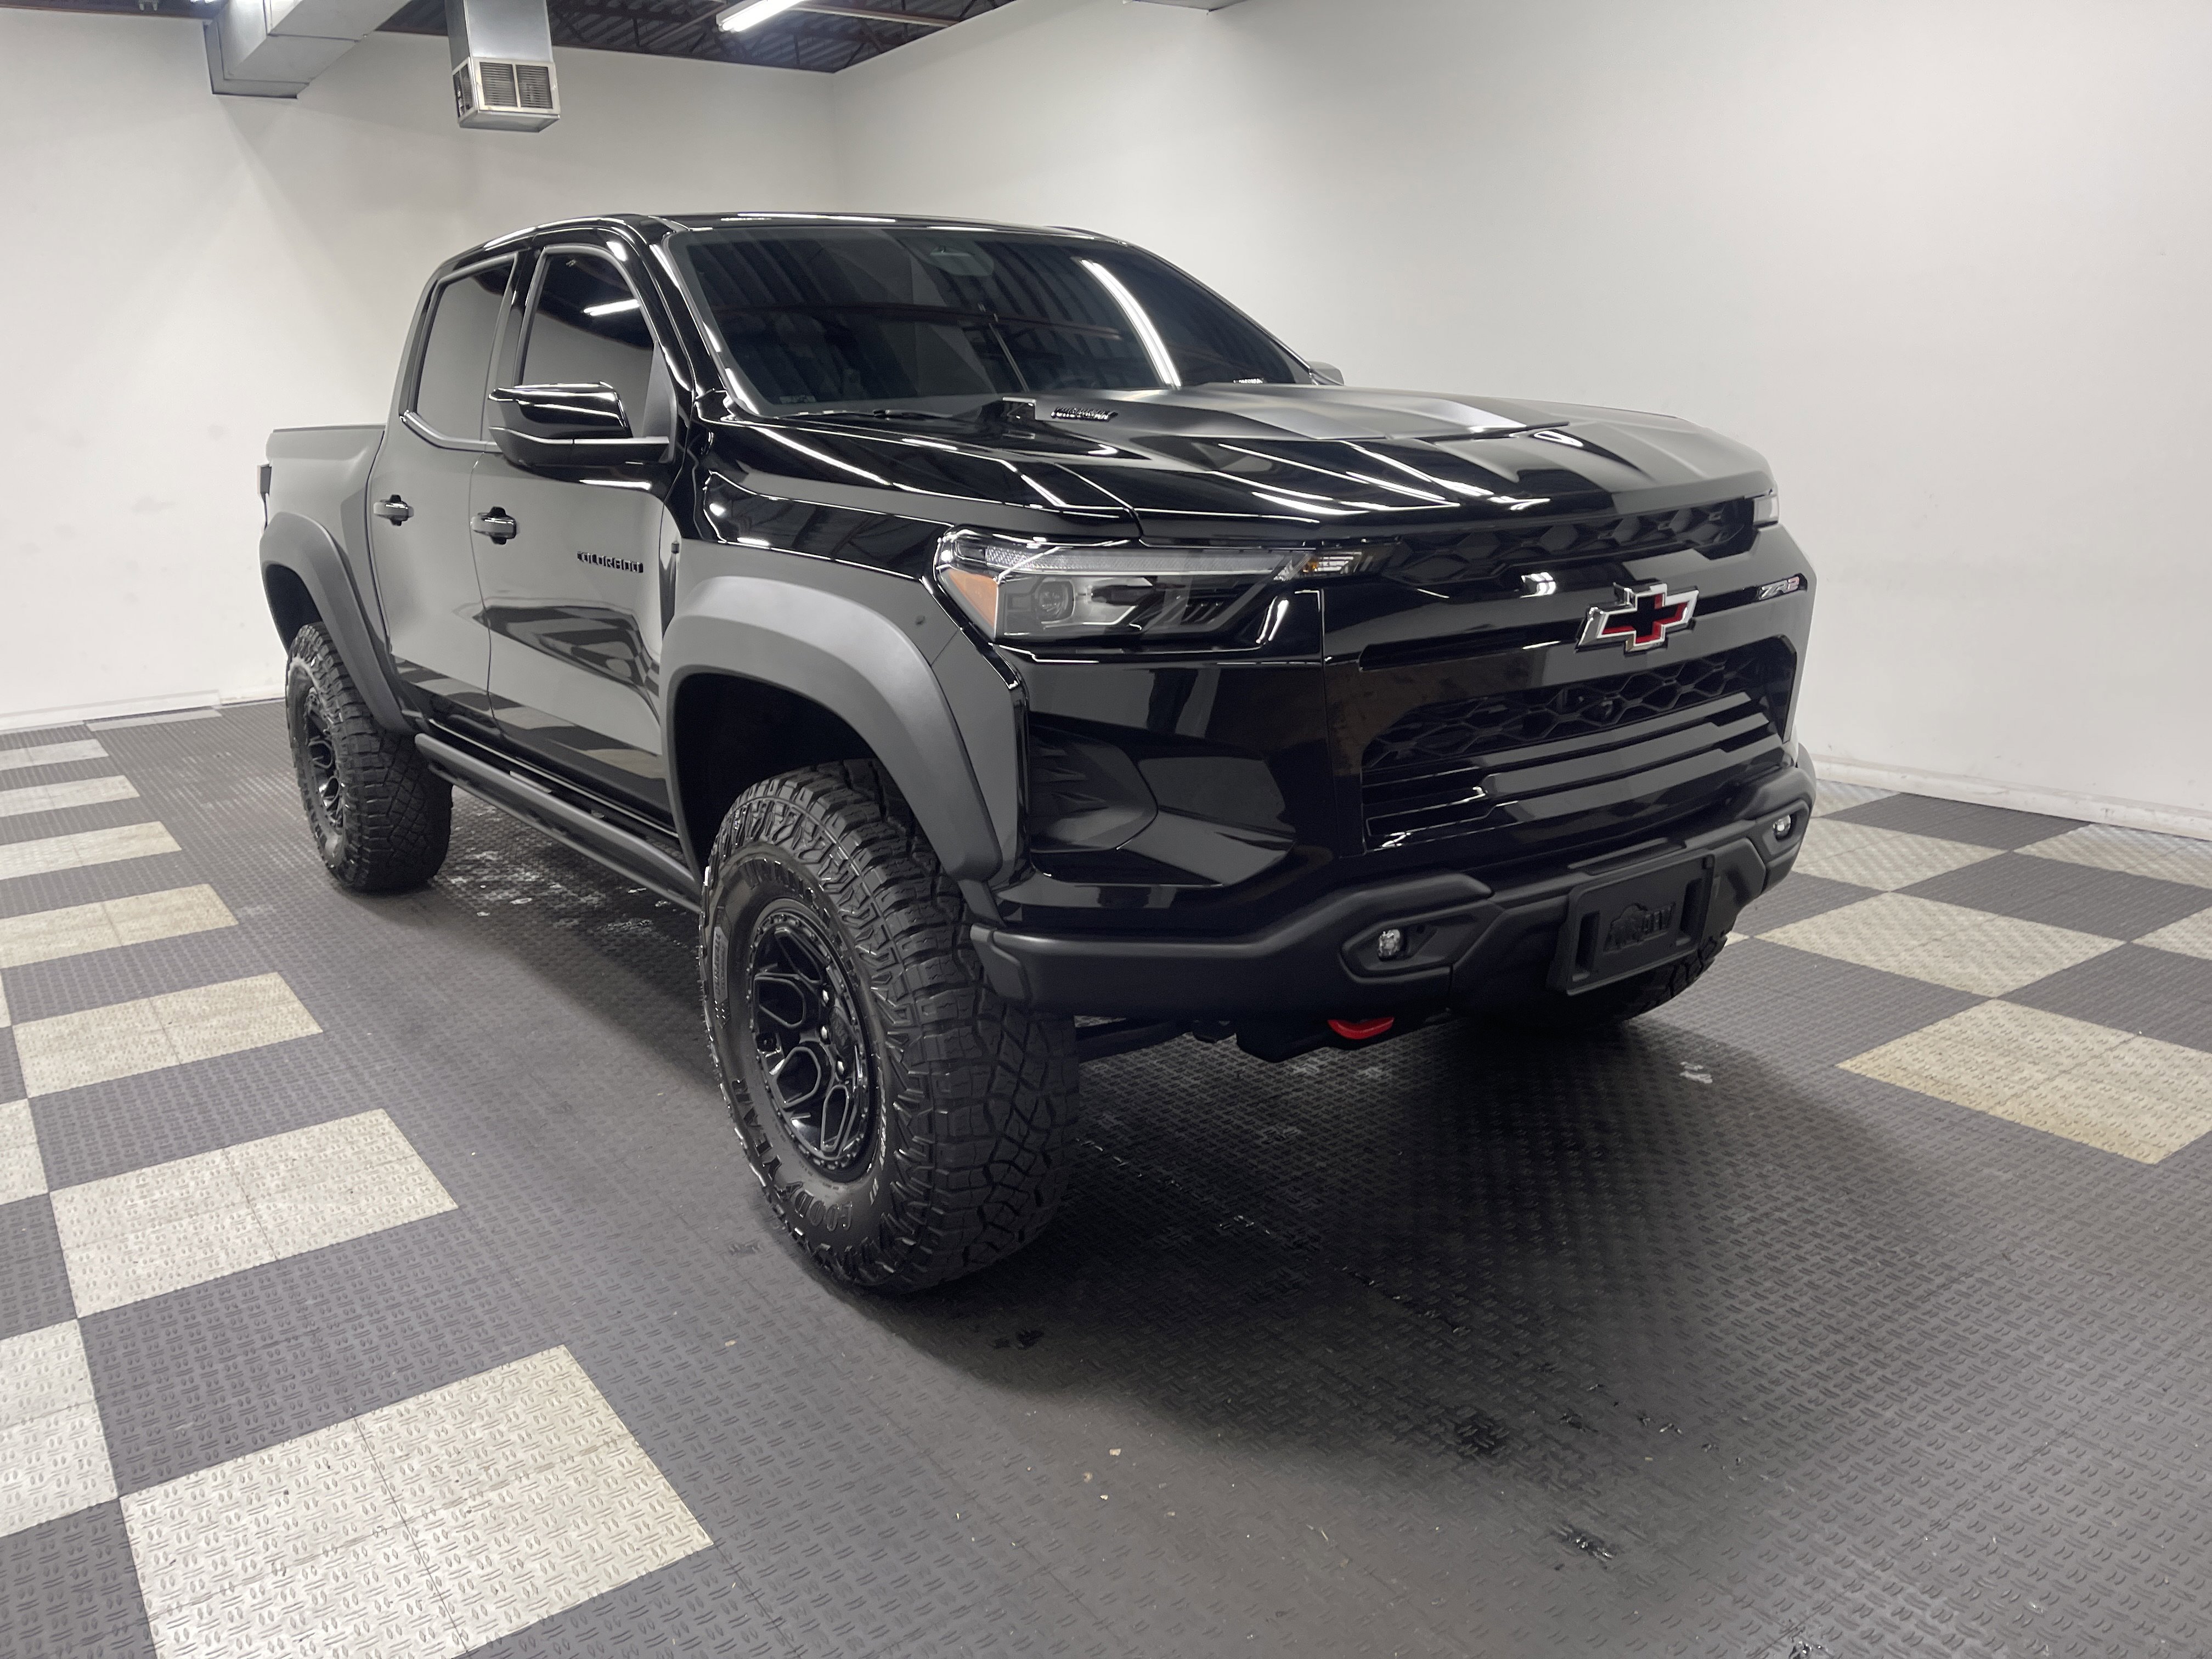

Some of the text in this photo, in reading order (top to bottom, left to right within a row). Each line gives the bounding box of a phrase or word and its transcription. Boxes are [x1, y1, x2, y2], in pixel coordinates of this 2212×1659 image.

[577, 551, 644, 573] COLORADO
[1759, 576, 1799, 600] ZR2
[732, 1079, 853, 1231] GOODYEAR
